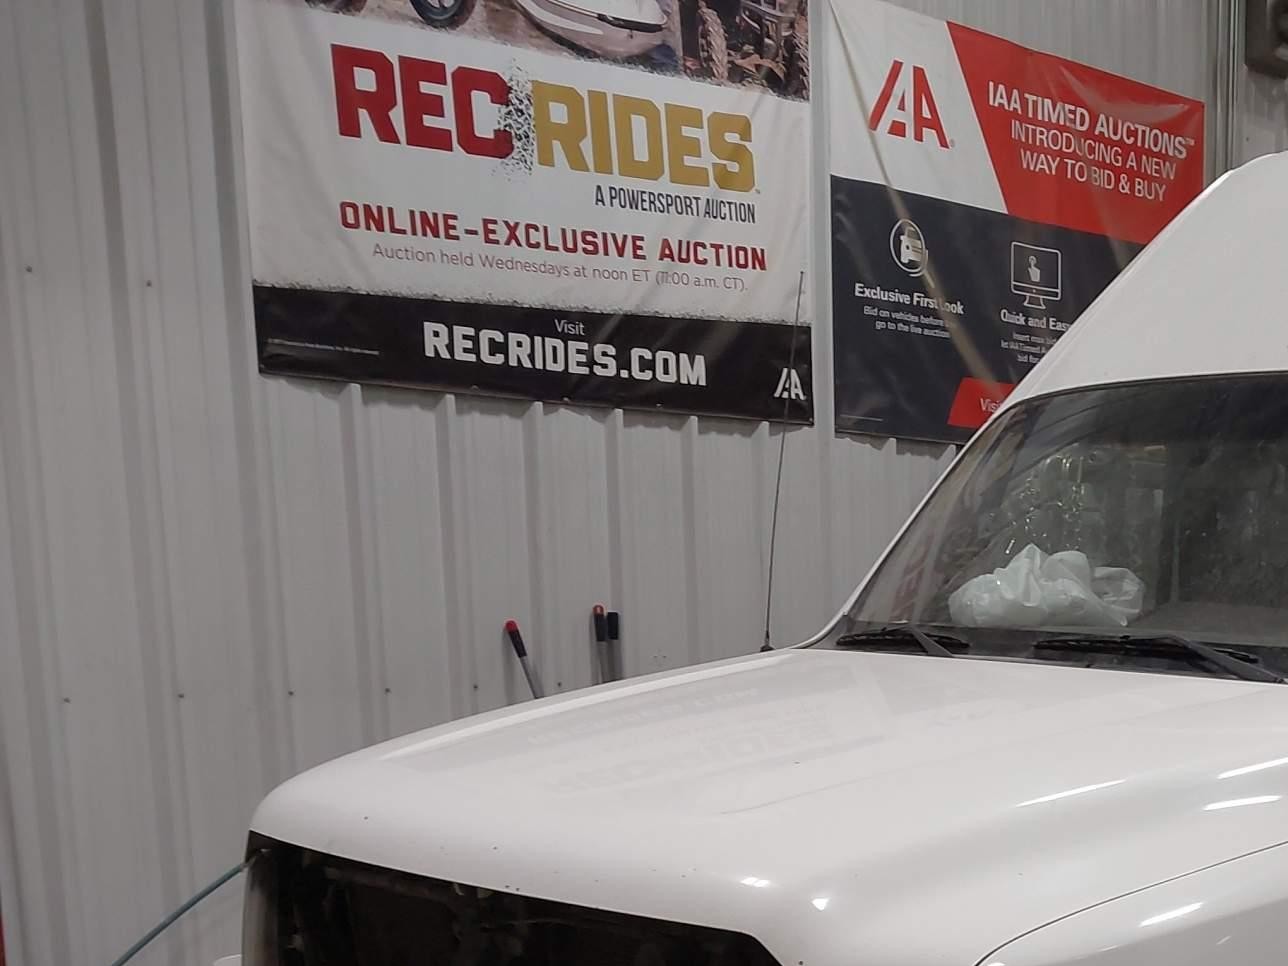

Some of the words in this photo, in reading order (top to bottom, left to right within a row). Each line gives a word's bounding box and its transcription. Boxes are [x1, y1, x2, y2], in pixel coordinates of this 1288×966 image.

[988, 81, 1022, 114] IAA
[1024, 92, 1090, 131] TIMED
[1011, 119, 1123, 167] INTRODUCING
[1126, 157, 1137, 169] A
[1141, 156, 1176, 180] NEW
[1020, 149, 1059, 175] WAY
[1063, 159, 1088, 182] TO
[1091, 166, 1115, 190] BID
[1118, 173, 1131, 194] &
[1135, 178, 1167, 201] BUY
[594, 185, 606, 206] A
[608, 186, 701, 217] POWERSPORT
[703, 198, 756, 224] AUCTION
[340, 201, 647, 260] ONLINE-EXCLUSIVE
[658, 238, 768, 271] AUCTION
[372, 243, 436, 262] Auction
[440, 249, 474, 267] held
[479, 254, 570, 278] Wednesdays
[574, 265, 587, 278] at
[592, 269, 628, 281] noon
[632, 269, 650, 282] ET
[854, 282, 911, 304] Exclusive
[863, 305, 878, 316] Bid
[555, 319, 585, 336] Visit
[1001, 308, 1026, 325] Quick
[1027, 316, 1047, 329] and
[422, 321, 707, 387] RECRIDES.COM
